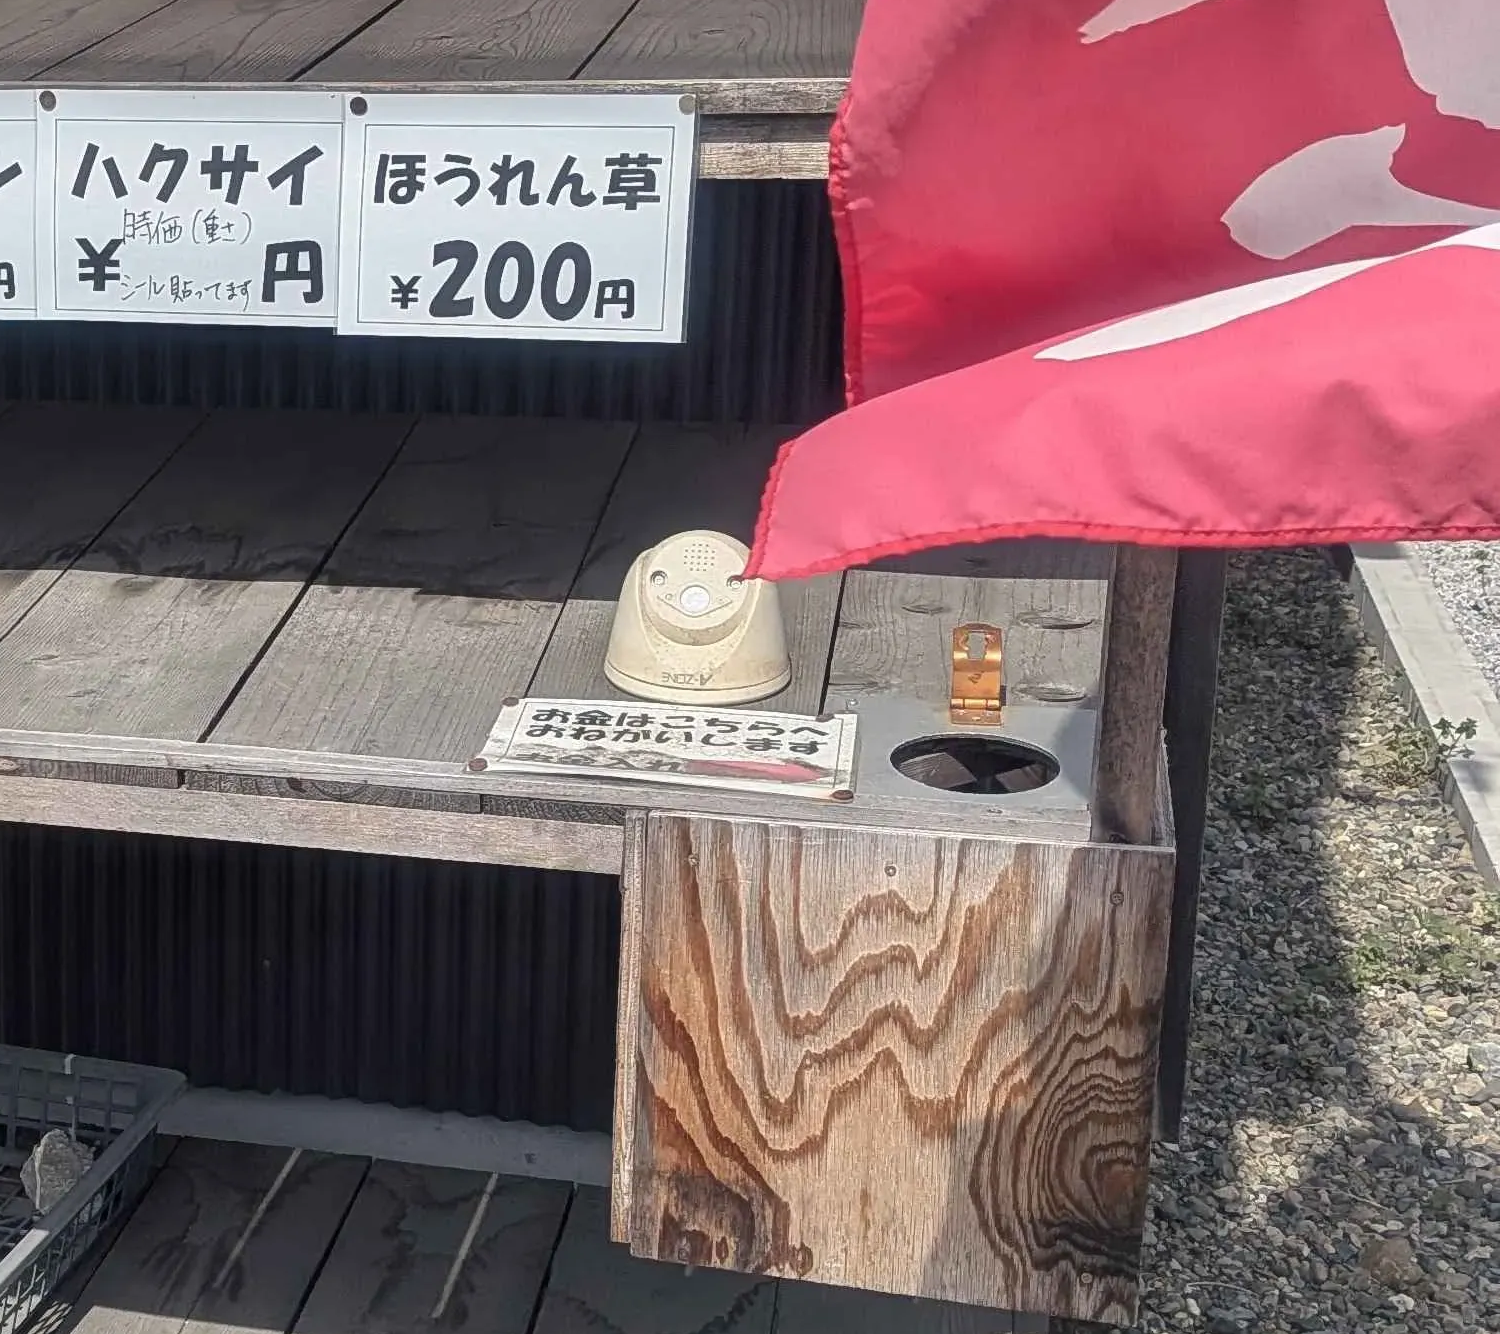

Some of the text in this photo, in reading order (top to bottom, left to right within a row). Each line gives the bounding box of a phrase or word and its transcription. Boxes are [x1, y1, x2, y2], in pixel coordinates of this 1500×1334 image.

[71, 143, 325, 207] ハクサイ
[373, 153, 663, 212] ほうれん草
[390, 239, 637, 322] ¥200円
[525, 723, 828, 755] おねがいします
[531, 708, 829, 737] お金はこちらへ
